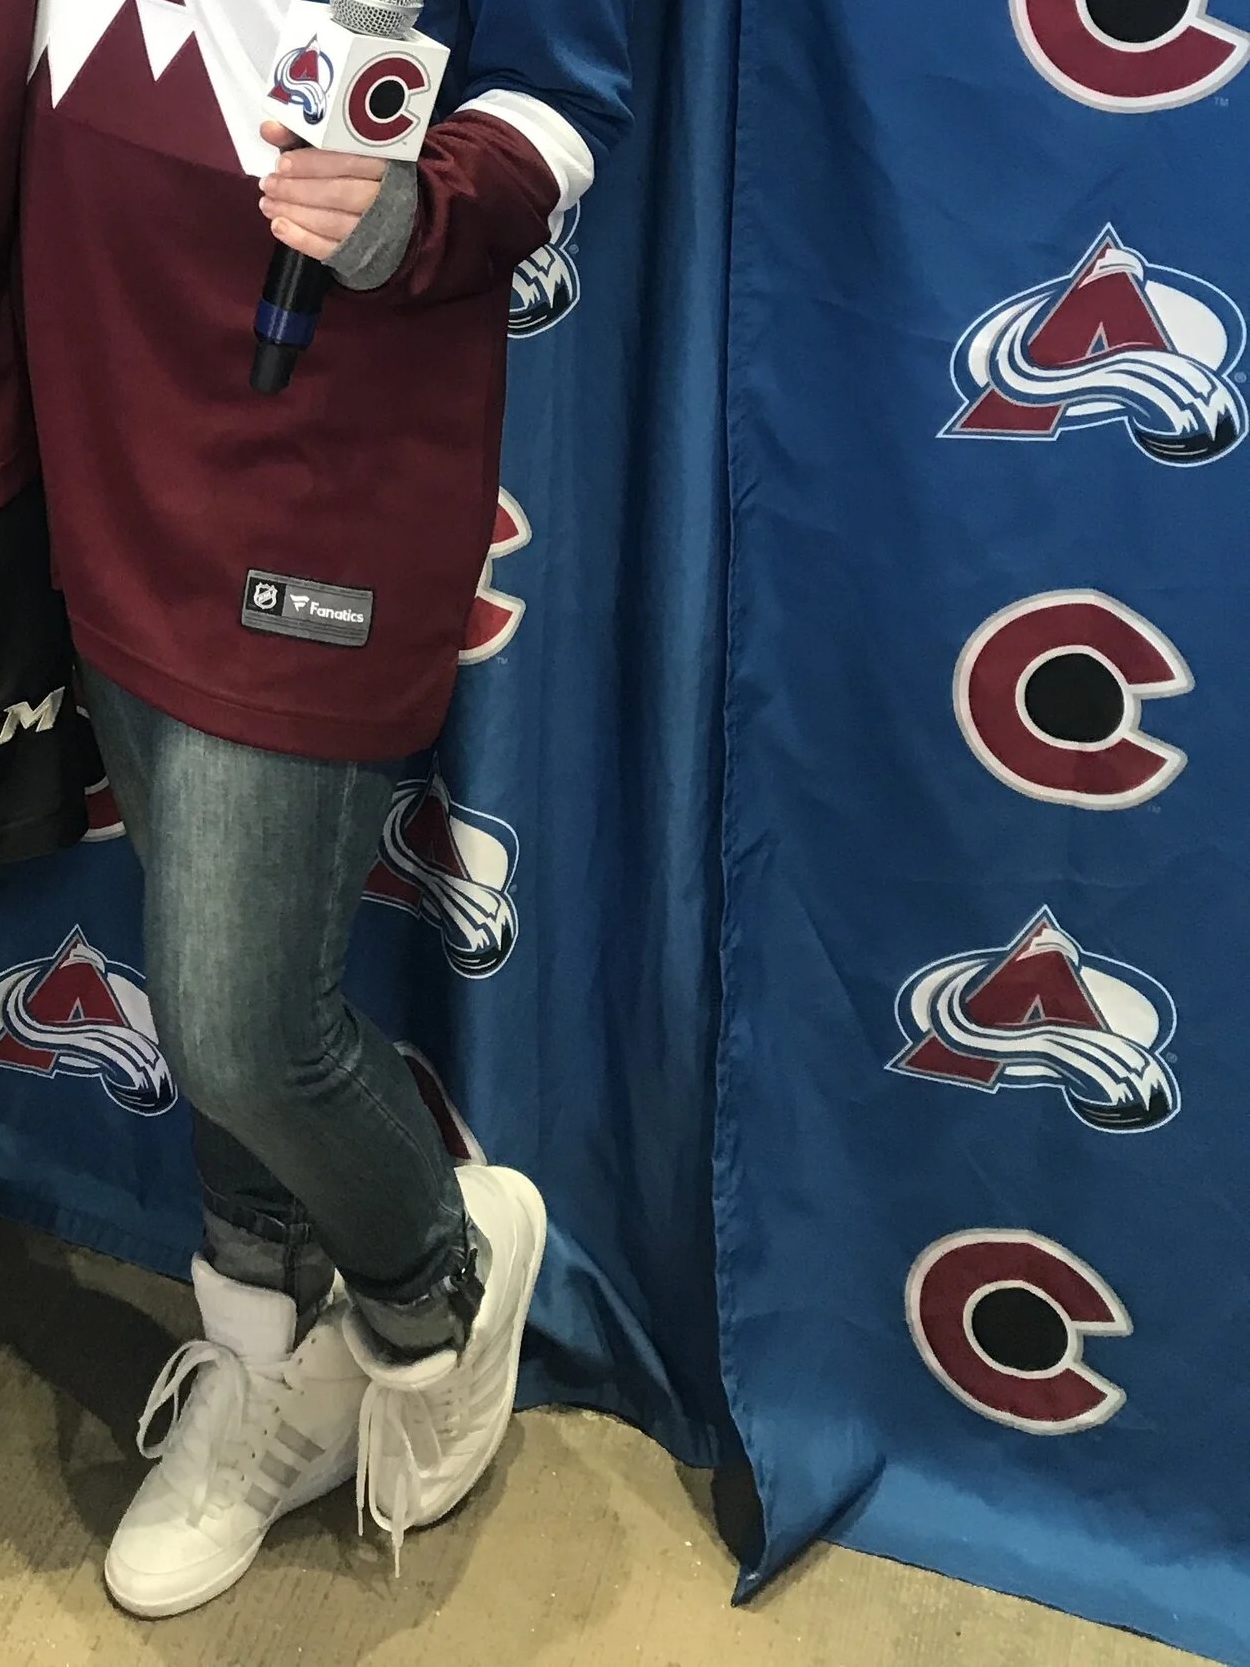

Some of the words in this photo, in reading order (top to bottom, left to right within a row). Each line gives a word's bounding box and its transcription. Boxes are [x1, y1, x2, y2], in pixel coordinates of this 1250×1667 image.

[342, 50, 431, 148] C
[309, 601, 364, 623] Fanatics
[952, 587, 1196, 812] C
[904, 1227, 1134, 1435] C
